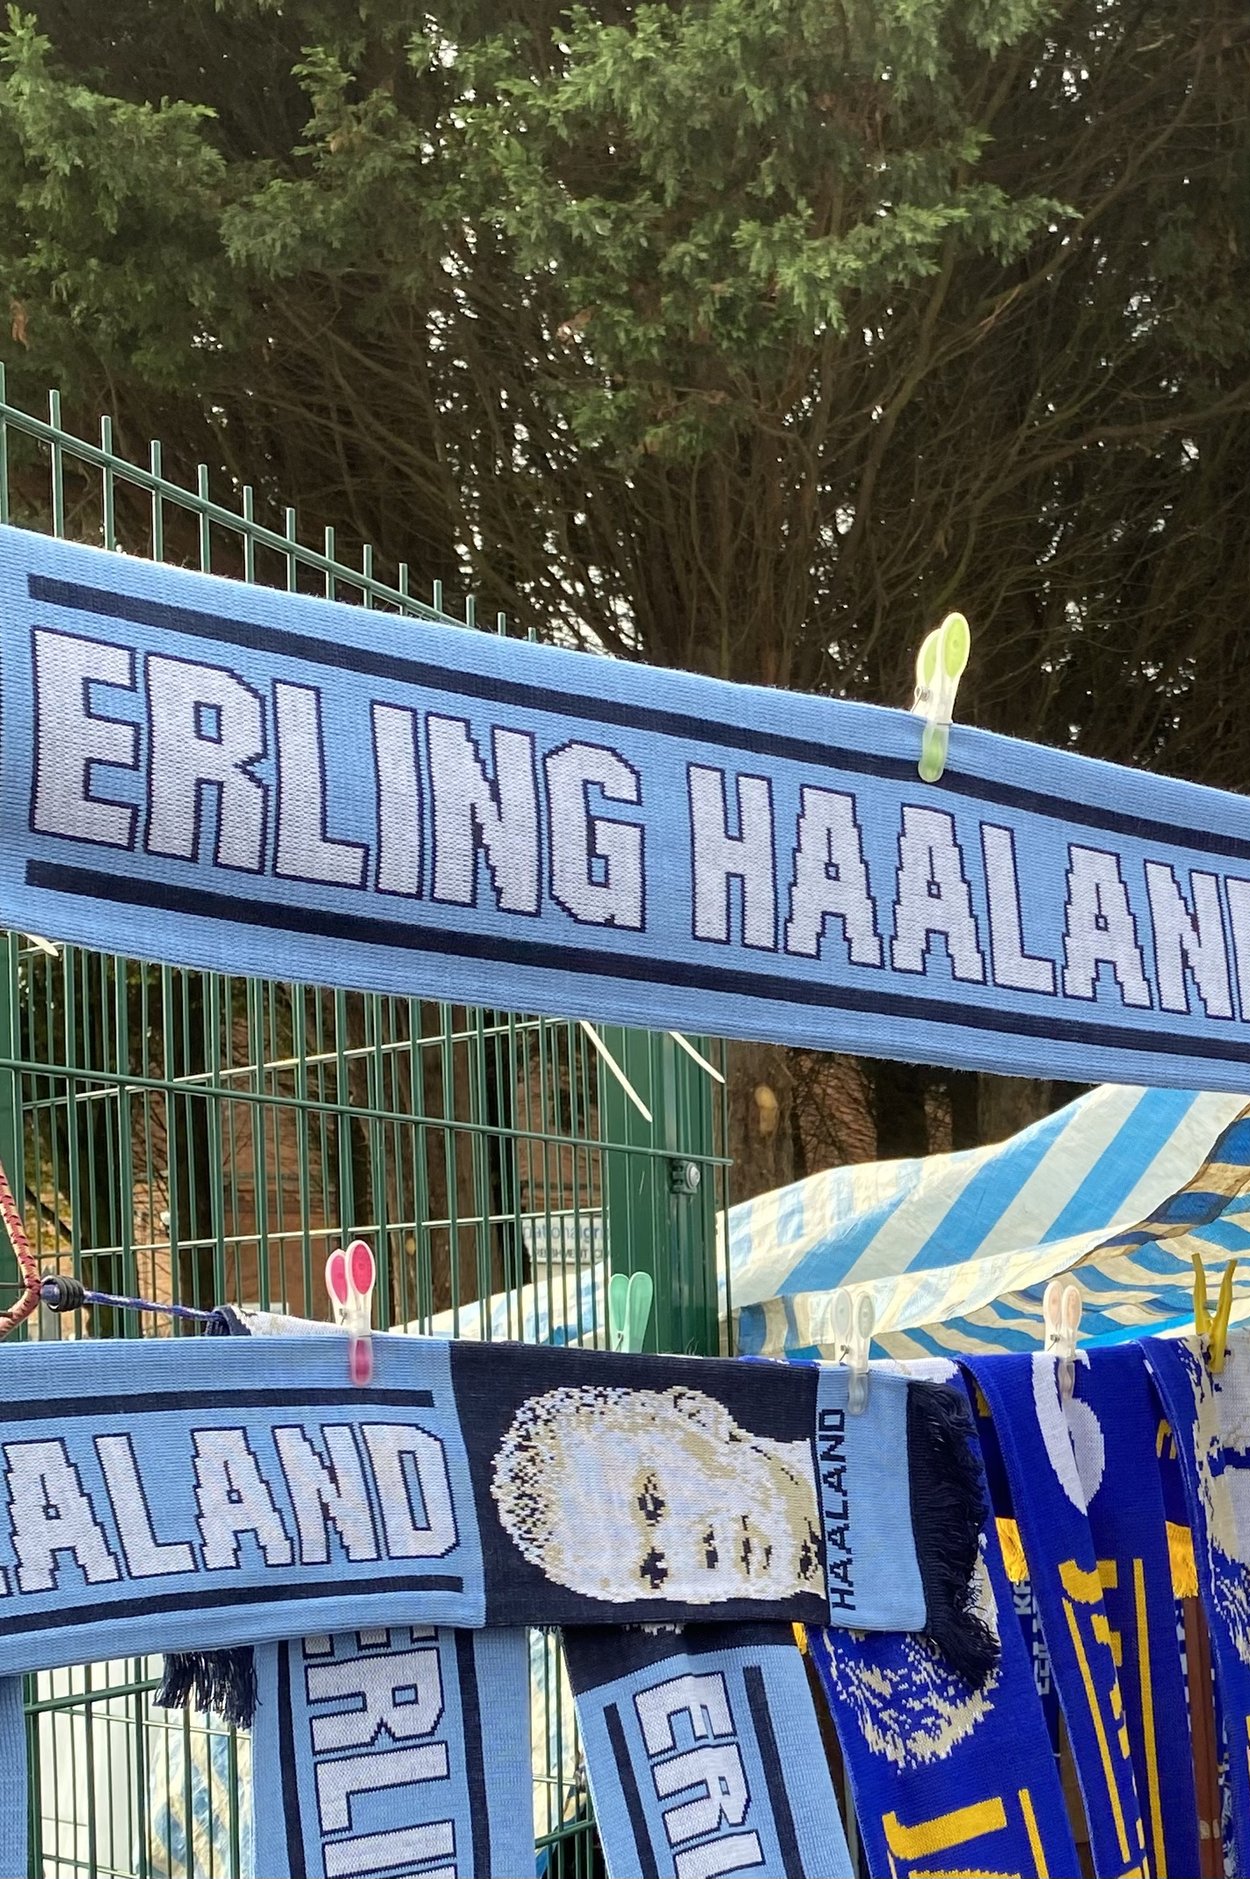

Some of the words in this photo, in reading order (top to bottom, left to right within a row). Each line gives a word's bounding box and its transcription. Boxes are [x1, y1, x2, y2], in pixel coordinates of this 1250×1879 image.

[30, 626, 647, 933] ERLING
[0, 1422, 460, 1597] ALAND
[814, 1407, 857, 1613] HAALAND
